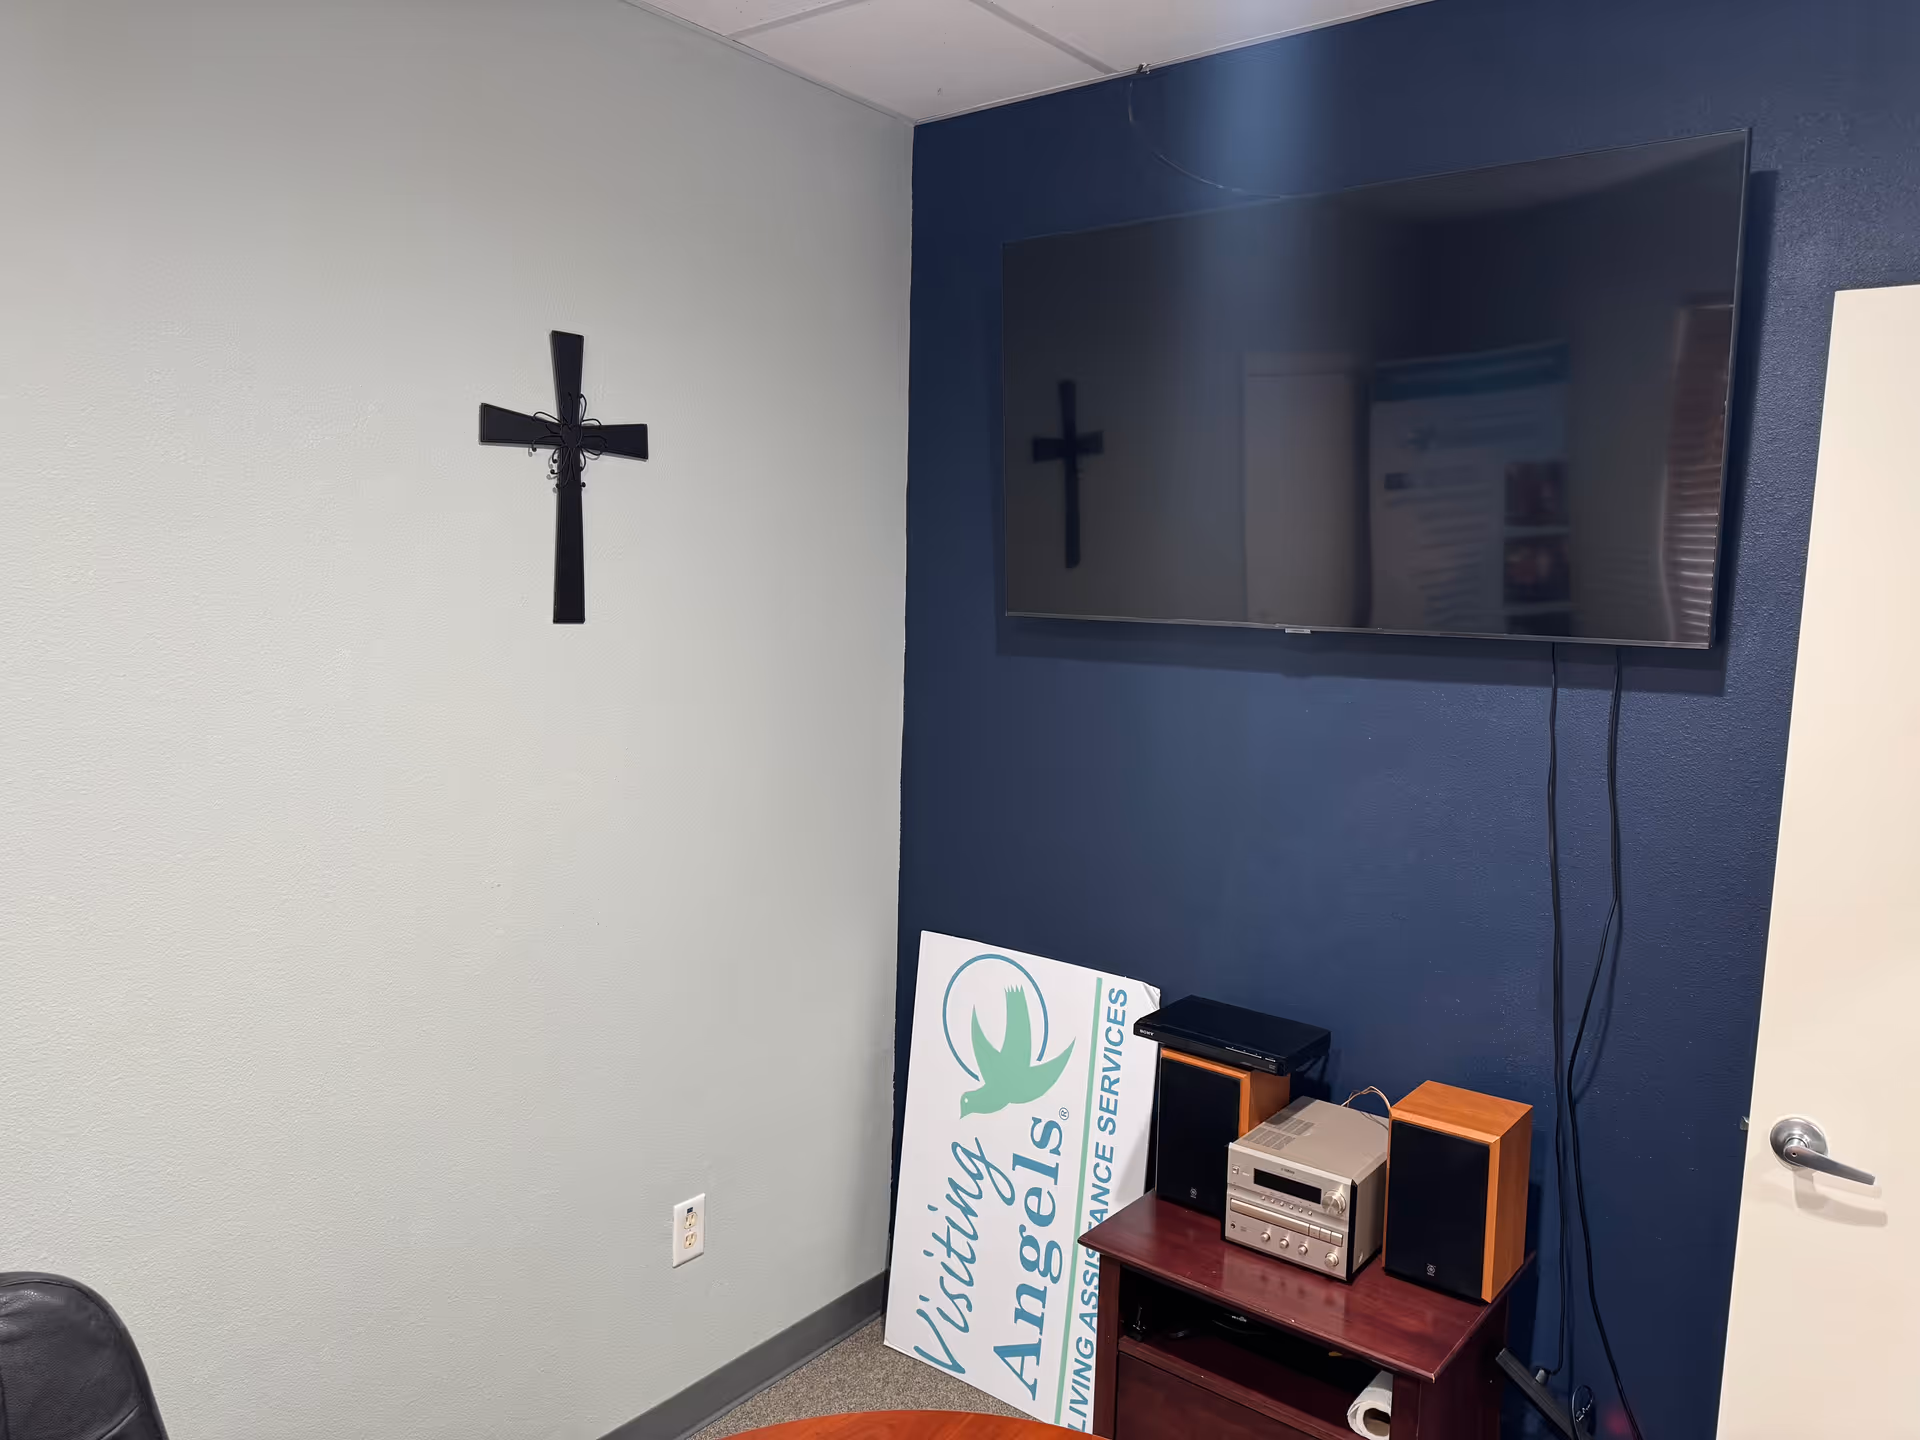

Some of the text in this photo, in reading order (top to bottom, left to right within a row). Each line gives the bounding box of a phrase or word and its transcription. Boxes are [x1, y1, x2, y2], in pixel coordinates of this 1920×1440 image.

[1096, 987, 1128, 1136] SERVICES
[913, 1137, 1016, 1375] Visiting
[1079, 1141, 1114, 1334] ASSIANCE
